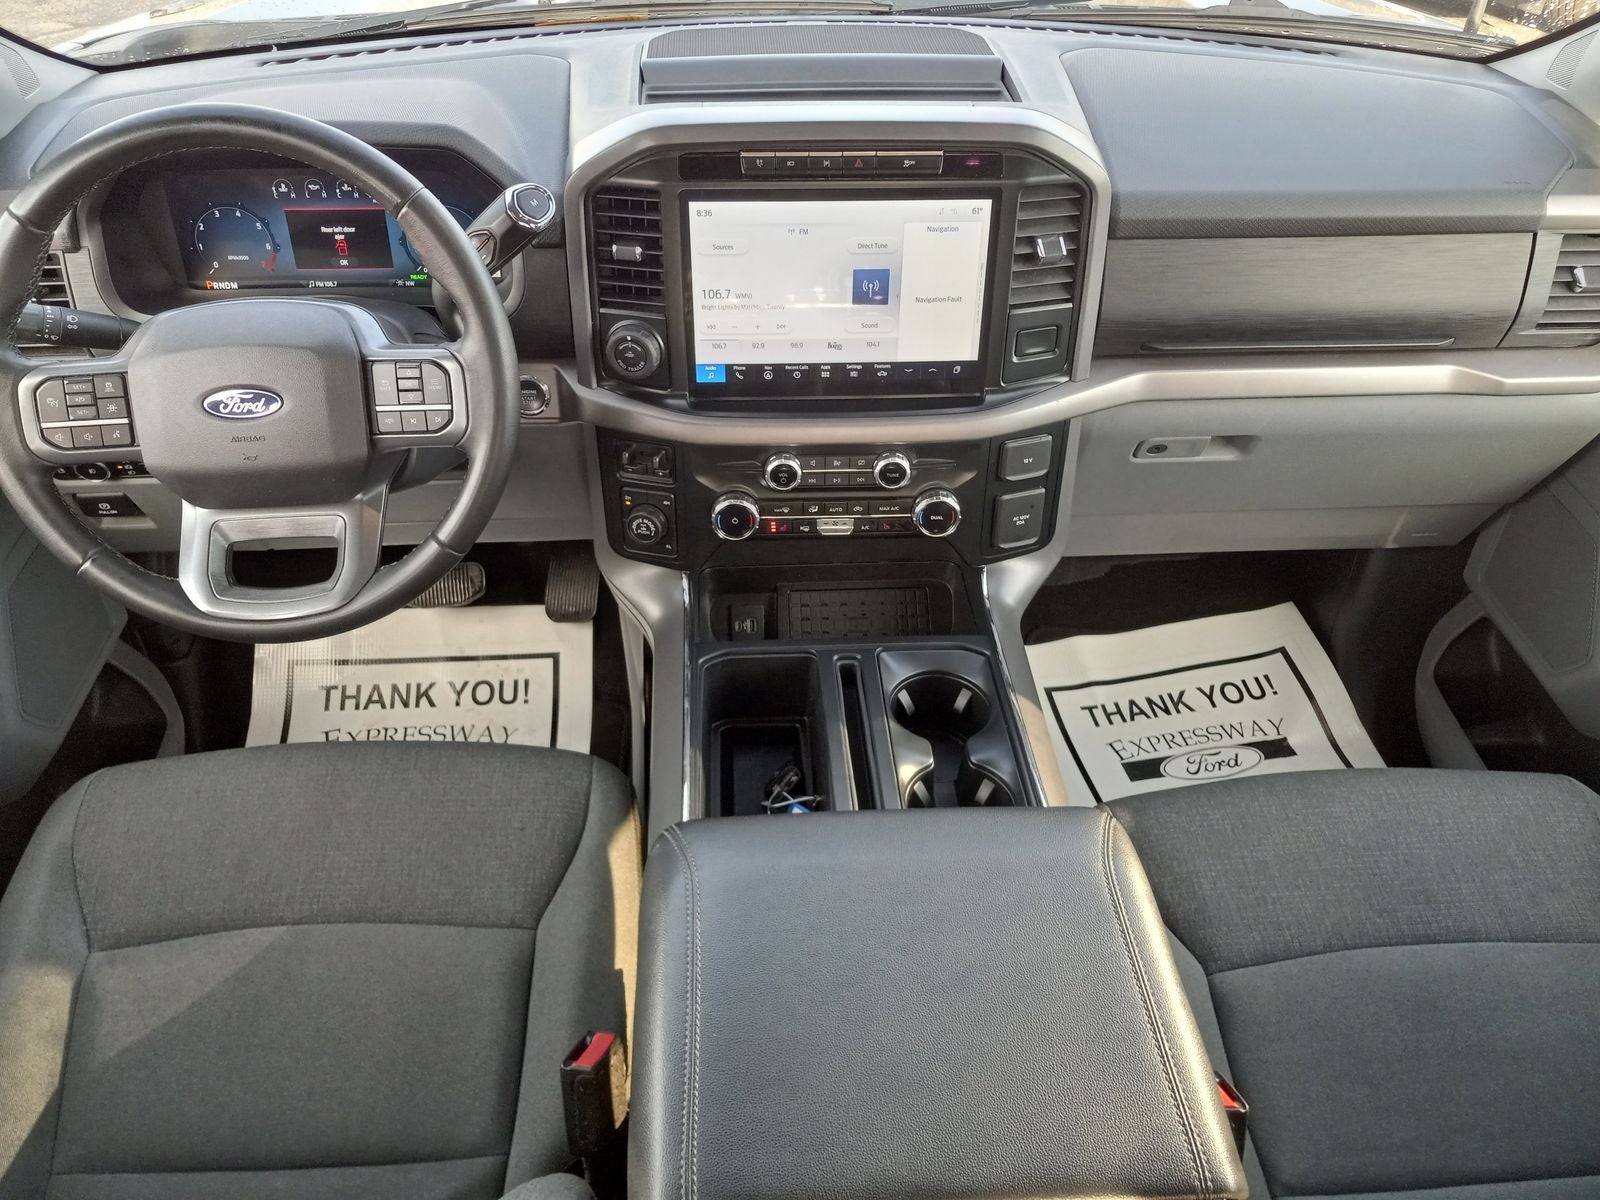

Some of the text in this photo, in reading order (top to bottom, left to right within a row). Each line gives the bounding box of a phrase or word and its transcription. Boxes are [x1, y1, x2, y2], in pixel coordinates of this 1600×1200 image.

[214, 210, 220, 218] 3
[696, 209, 713, 217] 8:36
[198, 223, 205, 231] 2
[927, 225, 960, 233] Navigation
[199, 243, 204, 251] 1
[701, 289, 731, 300] 106.7
[915, 295, 962, 305] Navigation Fault
[861, 321, 879, 329] Sound
[220, 394, 266, 414] Ford
[319, 678, 531, 712] THANK YOU!
[1080, 673, 1280, 728] THANK YOU!
[1105, 717, 1285, 761] EXPRESSWAY
[1185, 750, 1244, 775] Ford
